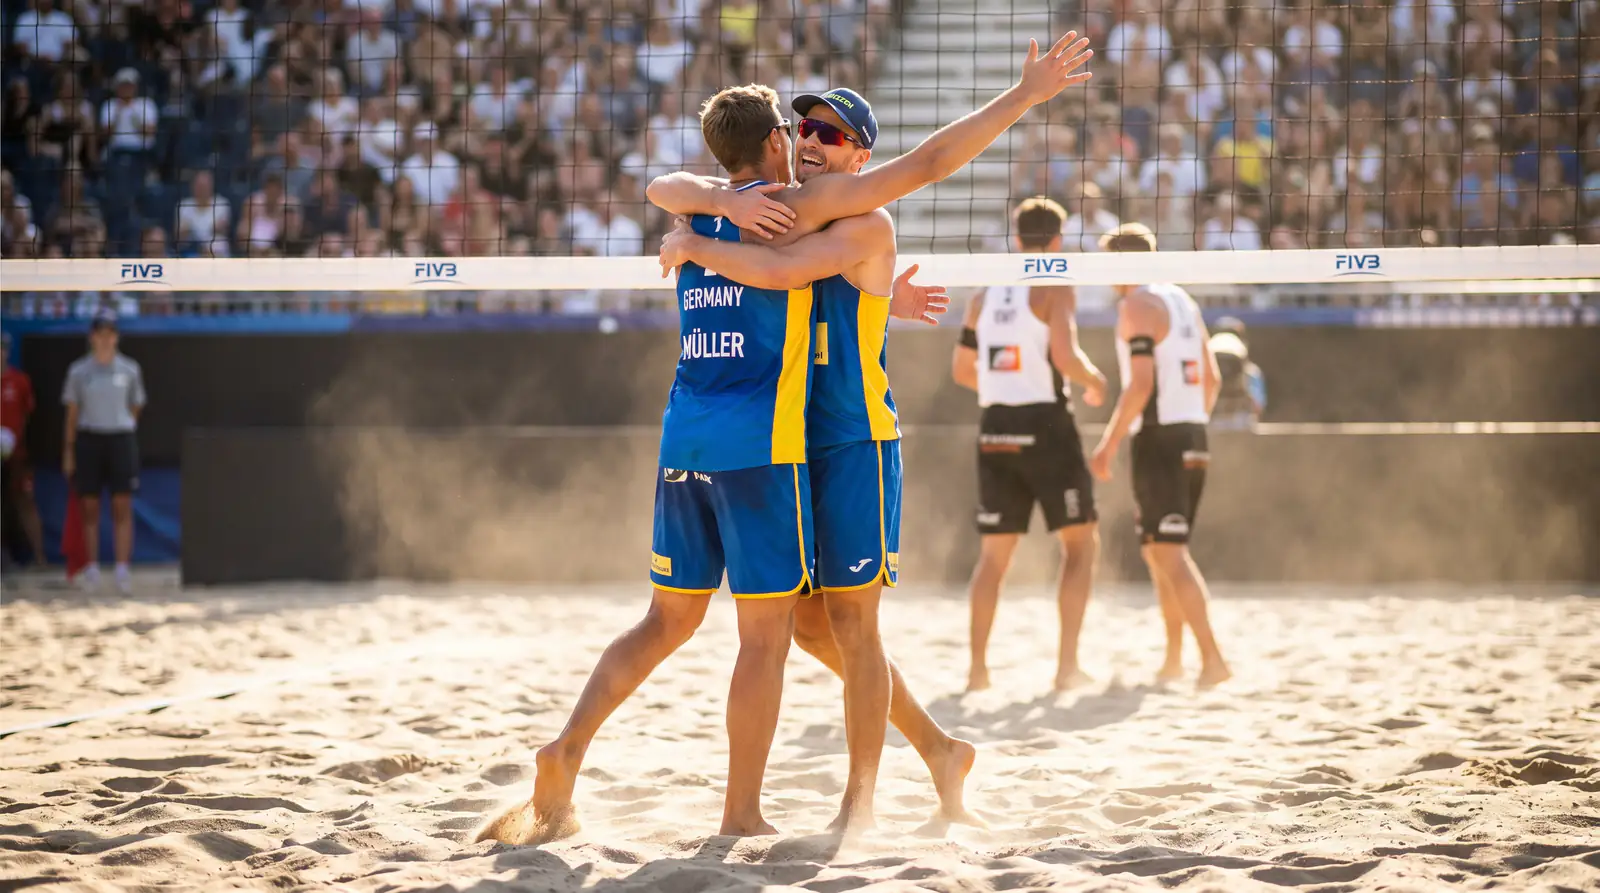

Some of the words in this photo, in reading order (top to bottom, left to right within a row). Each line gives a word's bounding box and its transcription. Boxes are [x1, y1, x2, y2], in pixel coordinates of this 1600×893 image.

[1024, 258, 1068, 273] FIVB
[1336, 254, 1380, 270] FIVB
[121, 264, 163, 278] FIVB
[415, 263, 457, 277] FIVB
[683, 286, 745, 311] GERMANY
[682, 327, 745, 361] MÜLLER
